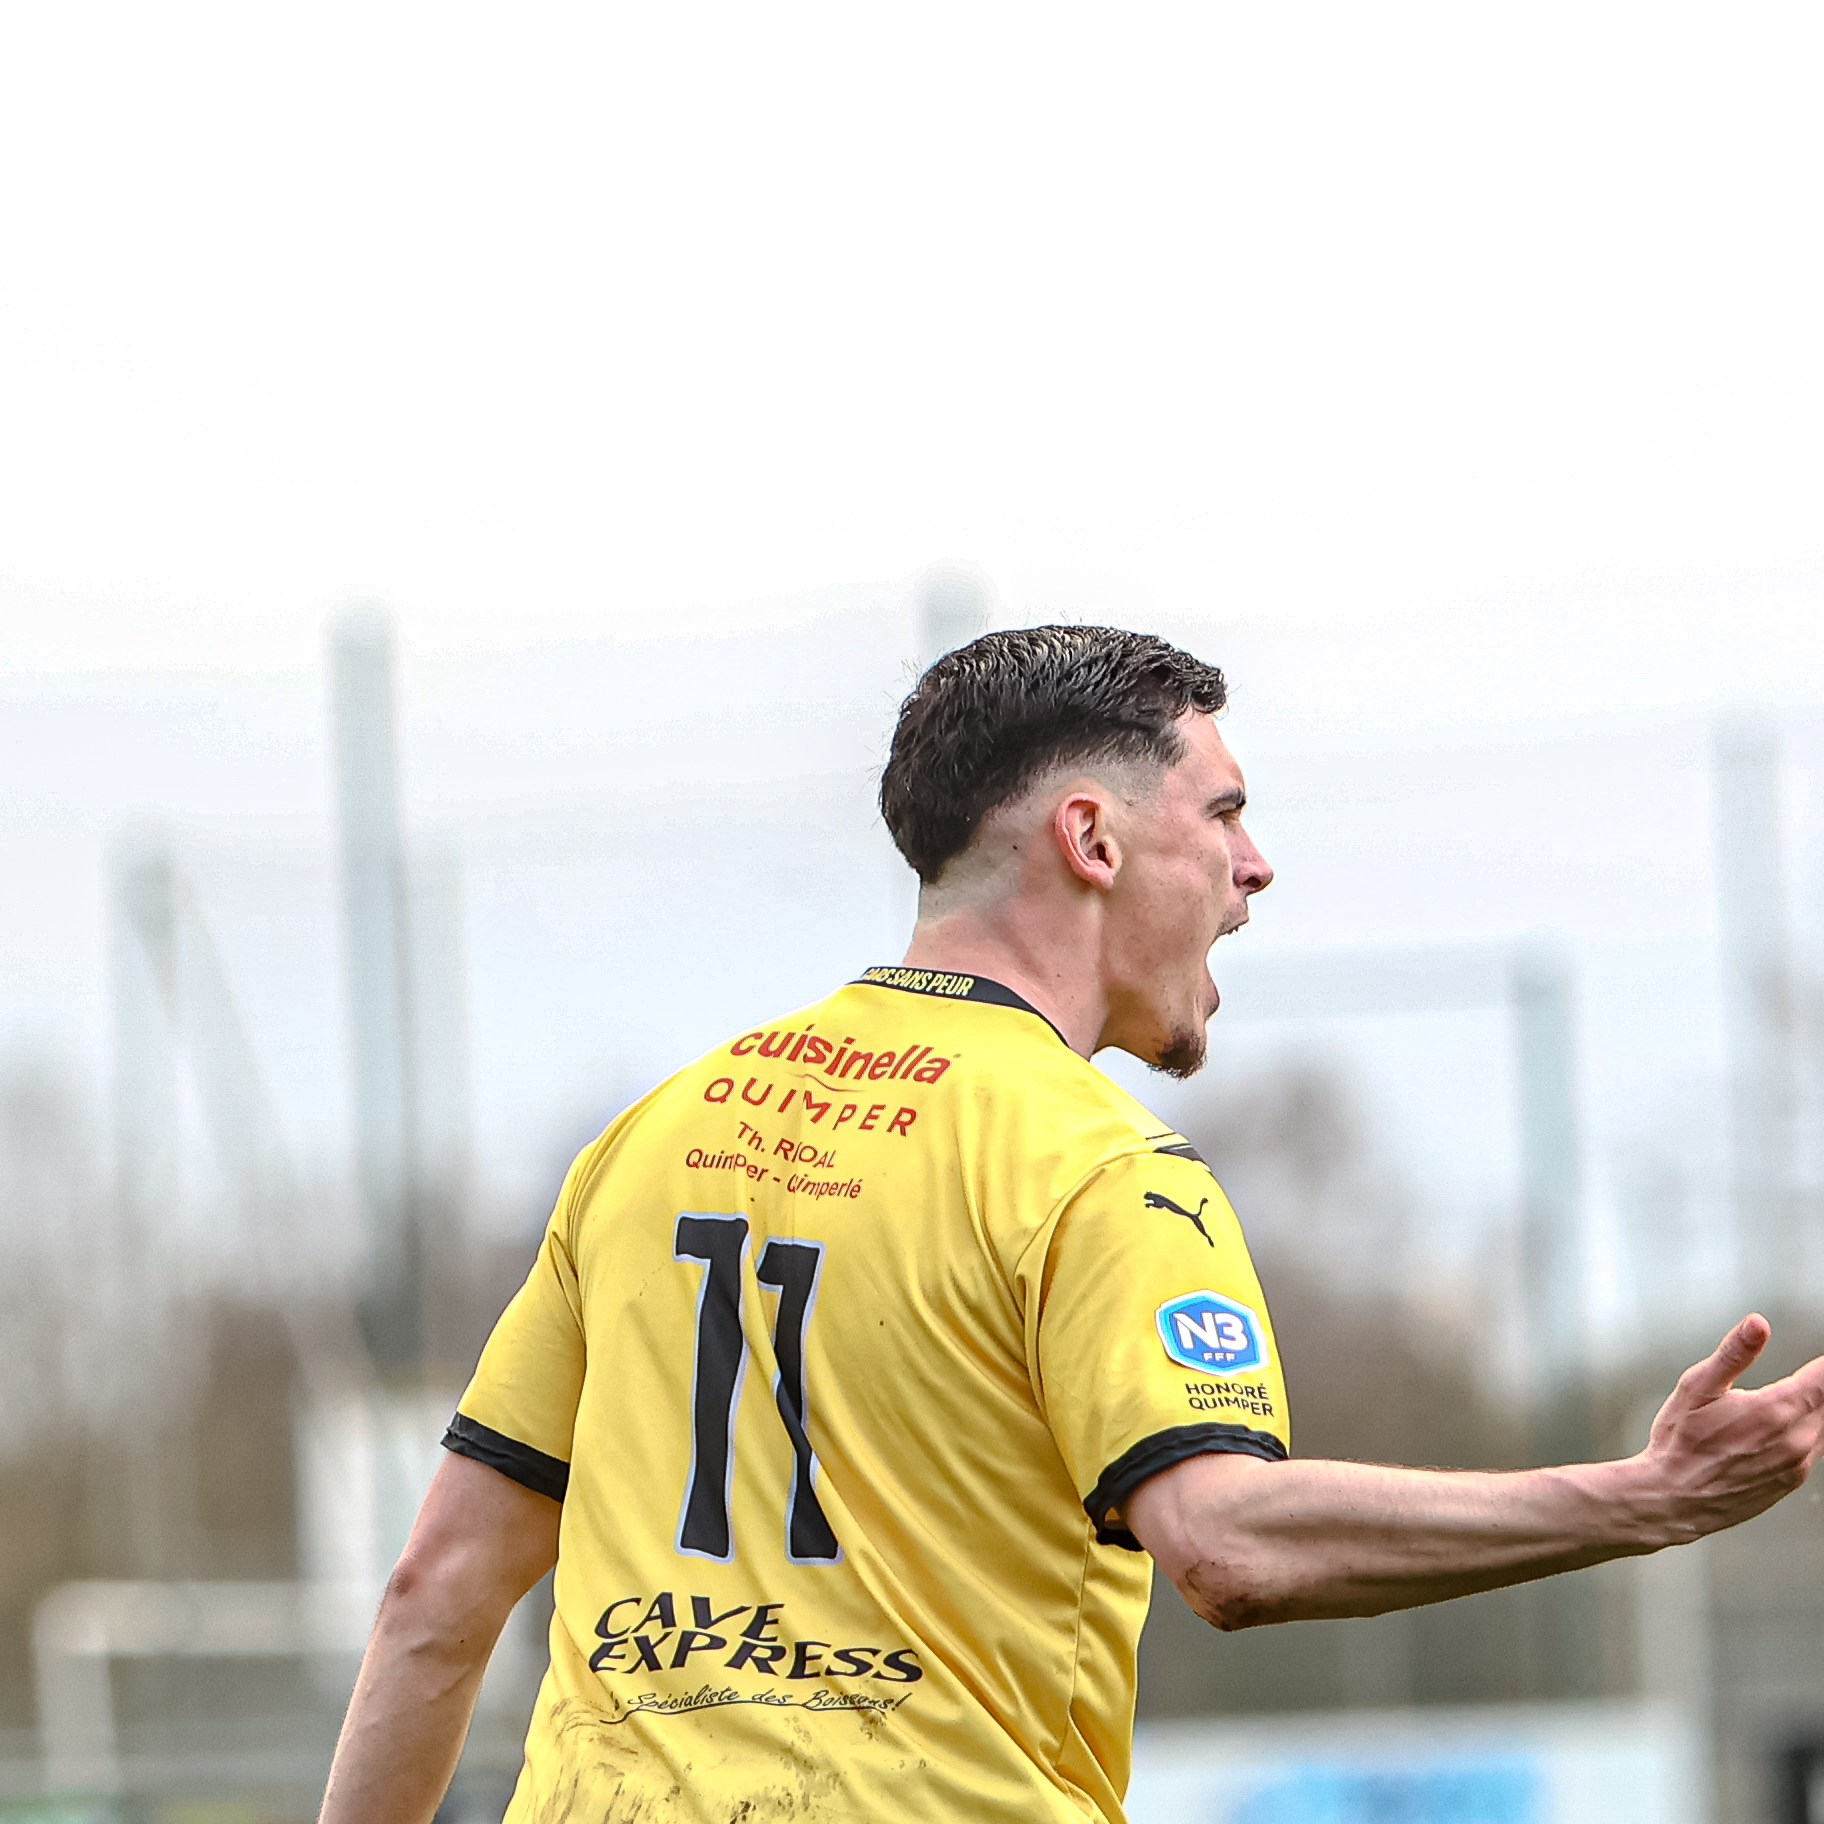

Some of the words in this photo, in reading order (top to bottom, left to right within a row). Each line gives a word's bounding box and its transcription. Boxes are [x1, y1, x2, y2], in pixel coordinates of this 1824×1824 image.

[894, 968, 933, 991] SANS
[926, 973, 975, 996] PEUR
[730, 1023, 951, 1085] cuisinella
[703, 1076, 917, 1137] QUIMPER
[737, 1121, 765, 1153] Th.
[1172, 1310, 1249, 1351] N3
[1202, 1352, 1237, 1362] FFF
[674, 1213, 841, 1563] 11
[1184, 1382, 1270, 1400] HONORÉ
[1188, 1396, 1274, 1418] QUIMPER
[594, 1591, 785, 1642] CAVE
[588, 1630, 923, 1682] EXPRESS
[627, 1684, 740, 1710] Spécialiste
[751, 1688, 793, 1703] des
